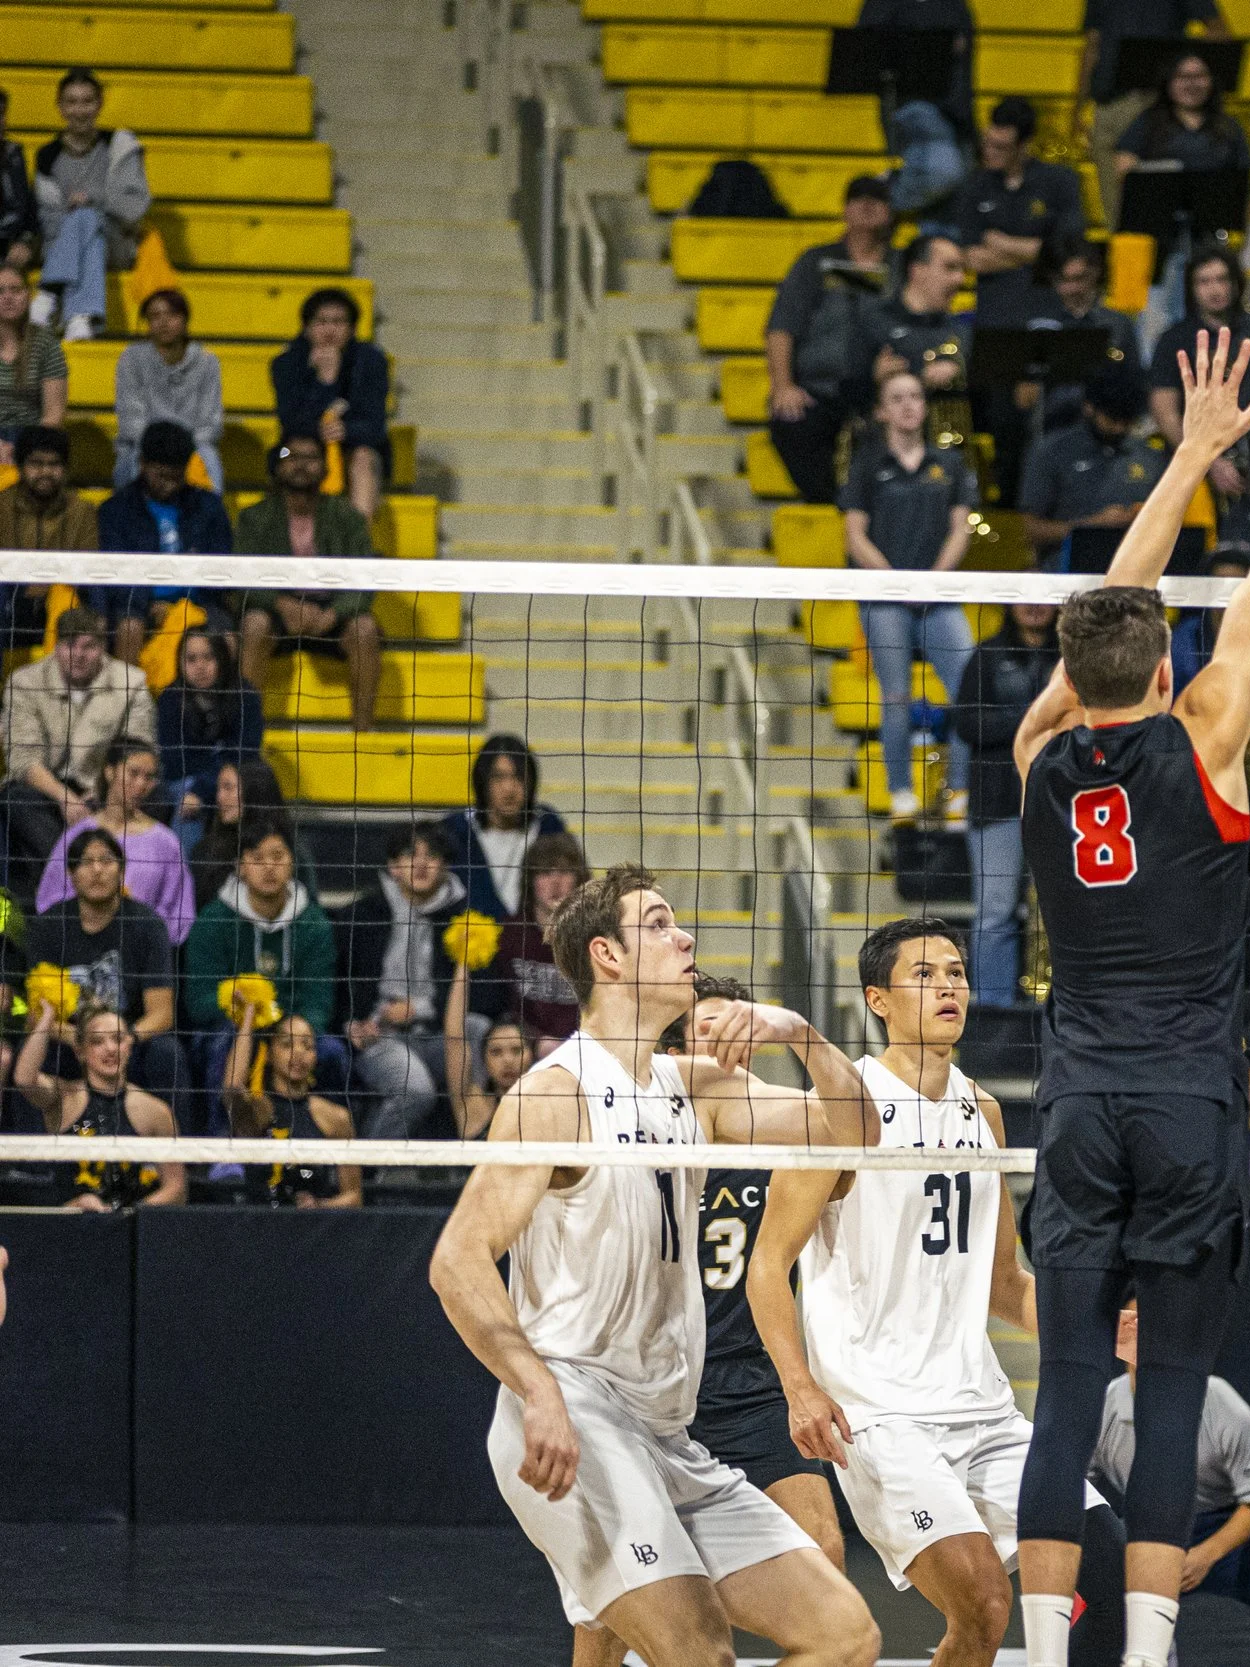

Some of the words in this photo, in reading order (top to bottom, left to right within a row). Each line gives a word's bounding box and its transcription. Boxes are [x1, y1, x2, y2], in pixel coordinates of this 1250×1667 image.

[1071, 783, 1138, 888] 8
[704, 1217, 747, 1290] 3
[921, 1171, 971, 1256] 31
